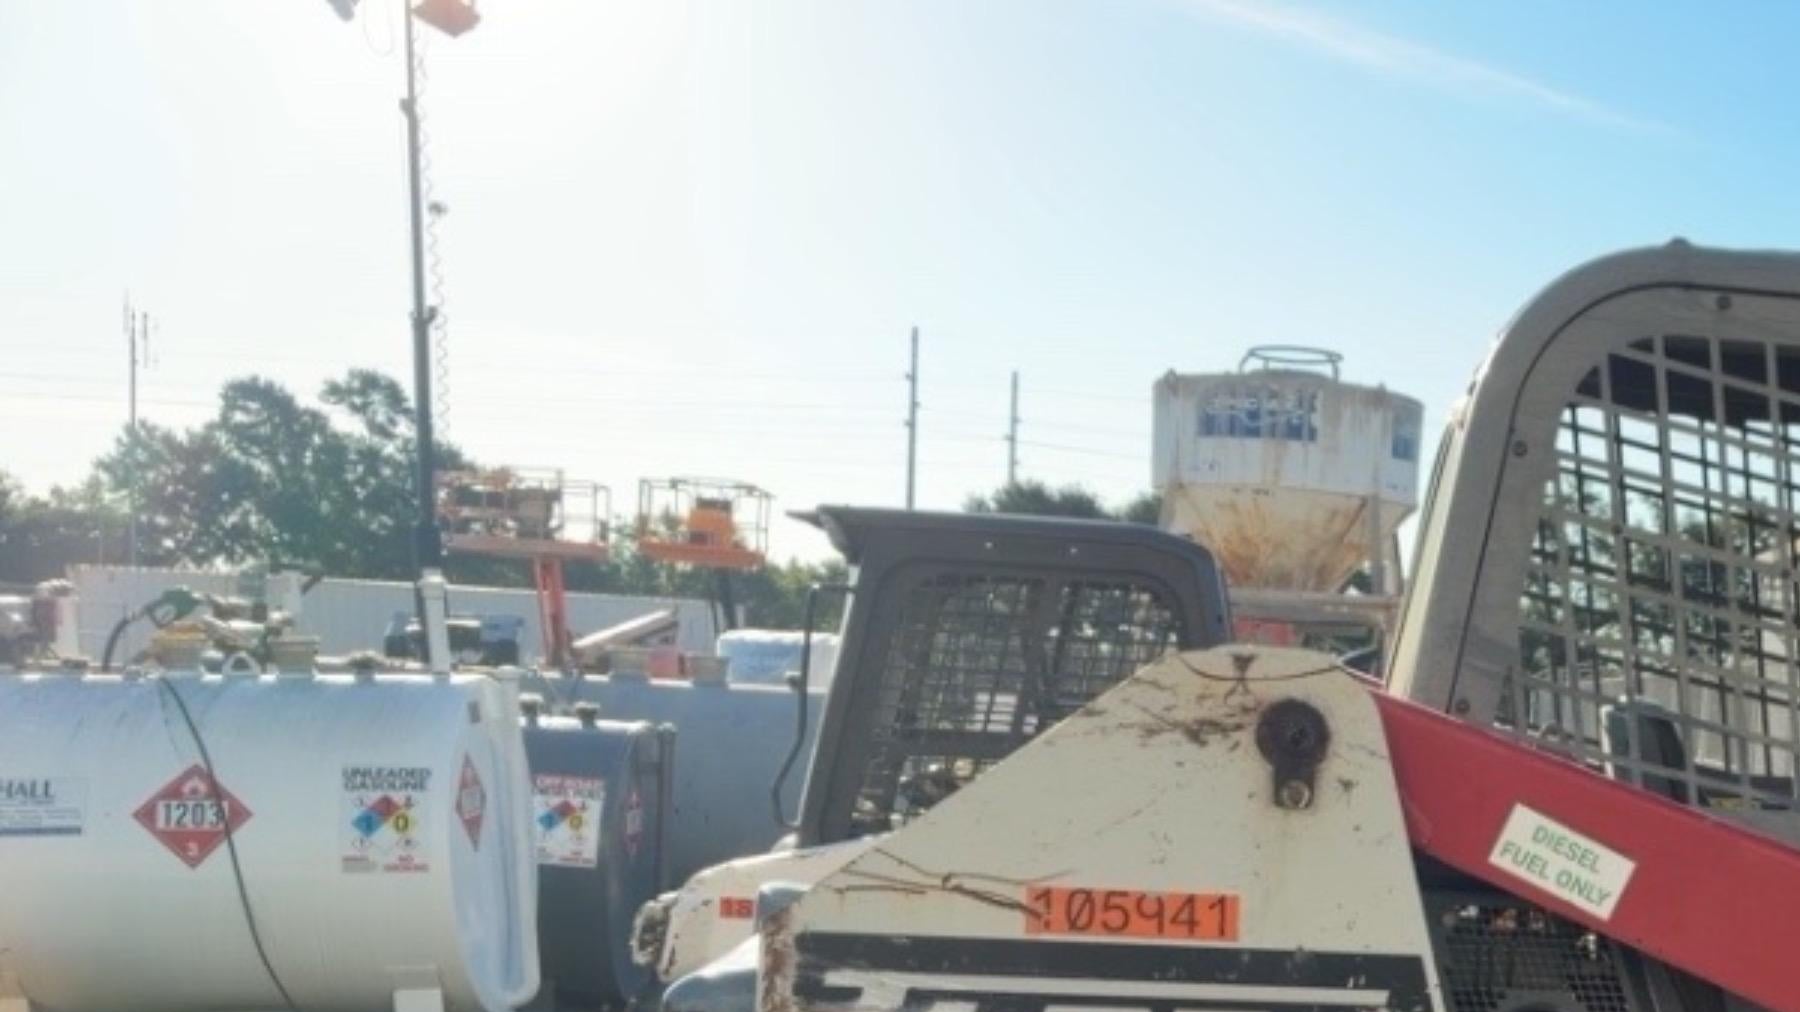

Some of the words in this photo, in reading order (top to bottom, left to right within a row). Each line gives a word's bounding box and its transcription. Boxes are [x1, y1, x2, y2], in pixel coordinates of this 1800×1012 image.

[163, 802, 225, 828] 1203
[1500, 840, 1552, 881] FUEL
[1555, 868, 1613, 907] ONLY
[1531, 823, 1603, 874] DIESEL
